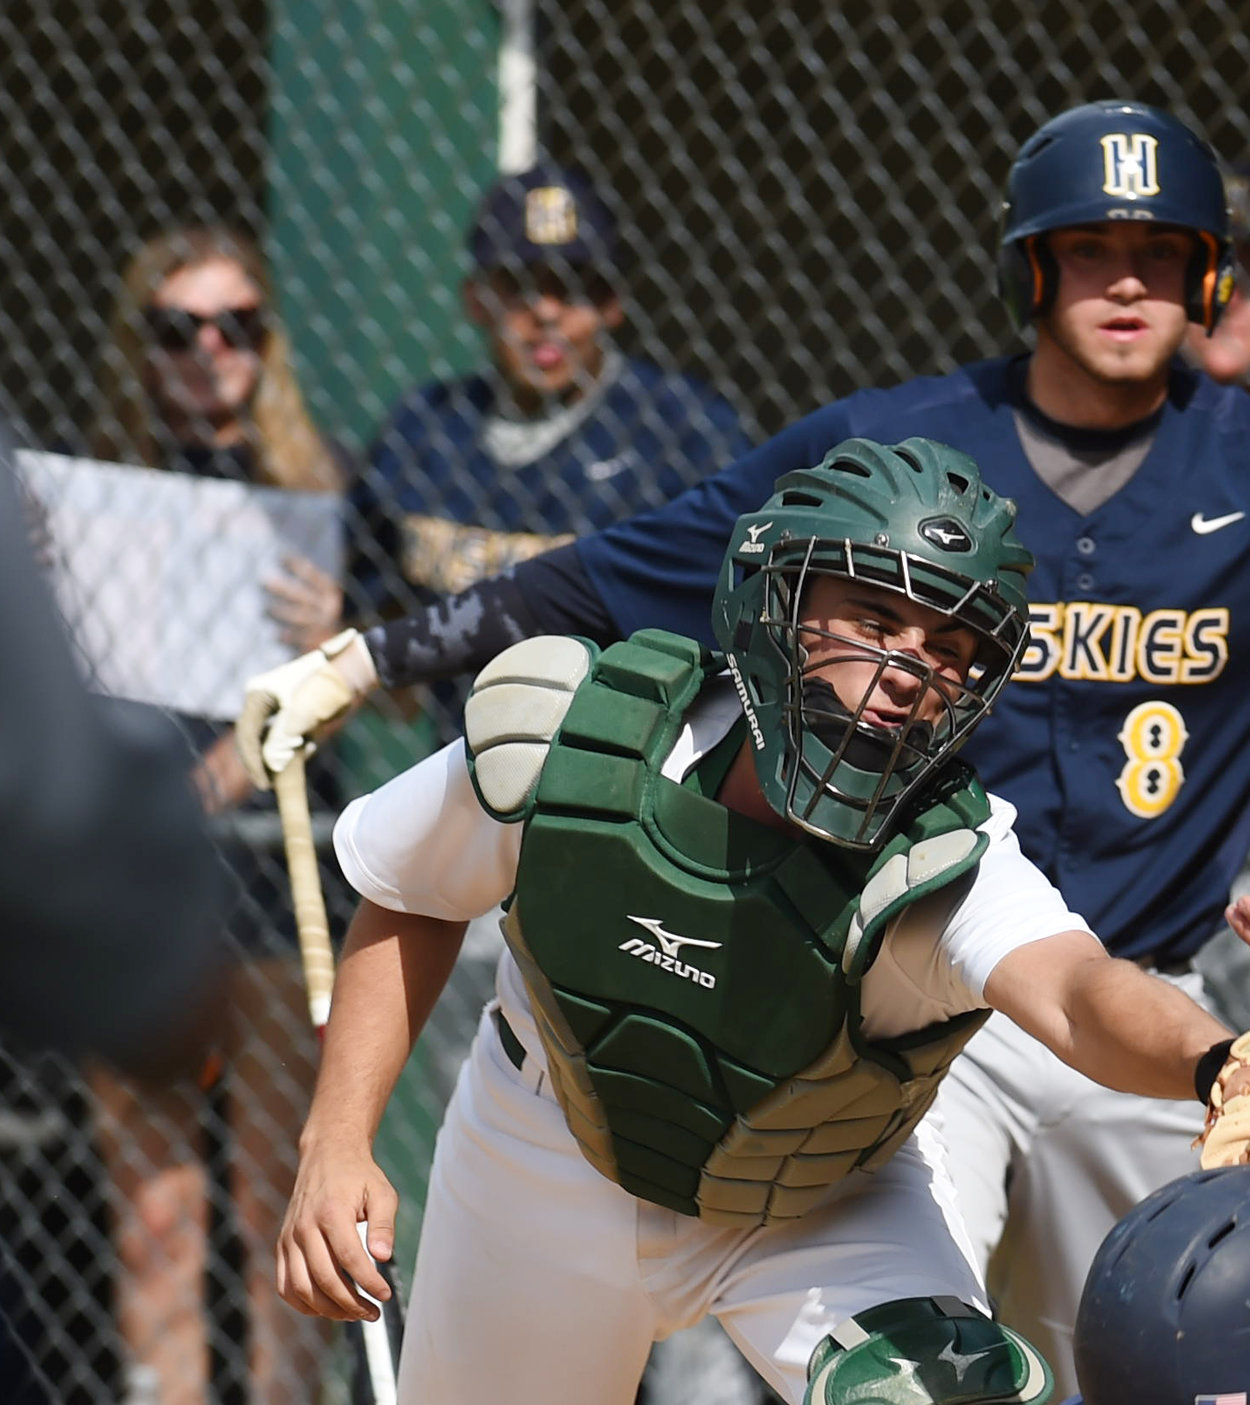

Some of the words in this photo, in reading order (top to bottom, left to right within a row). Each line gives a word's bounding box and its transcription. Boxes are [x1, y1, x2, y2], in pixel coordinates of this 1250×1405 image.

[1099, 133, 1161, 197] H
[1008, 601, 1230, 685] SKIES
[726, 652, 765, 751] SAMURAI
[1114, 700, 1190, 819] 8
[618, 938, 716, 989] MIZUNO
